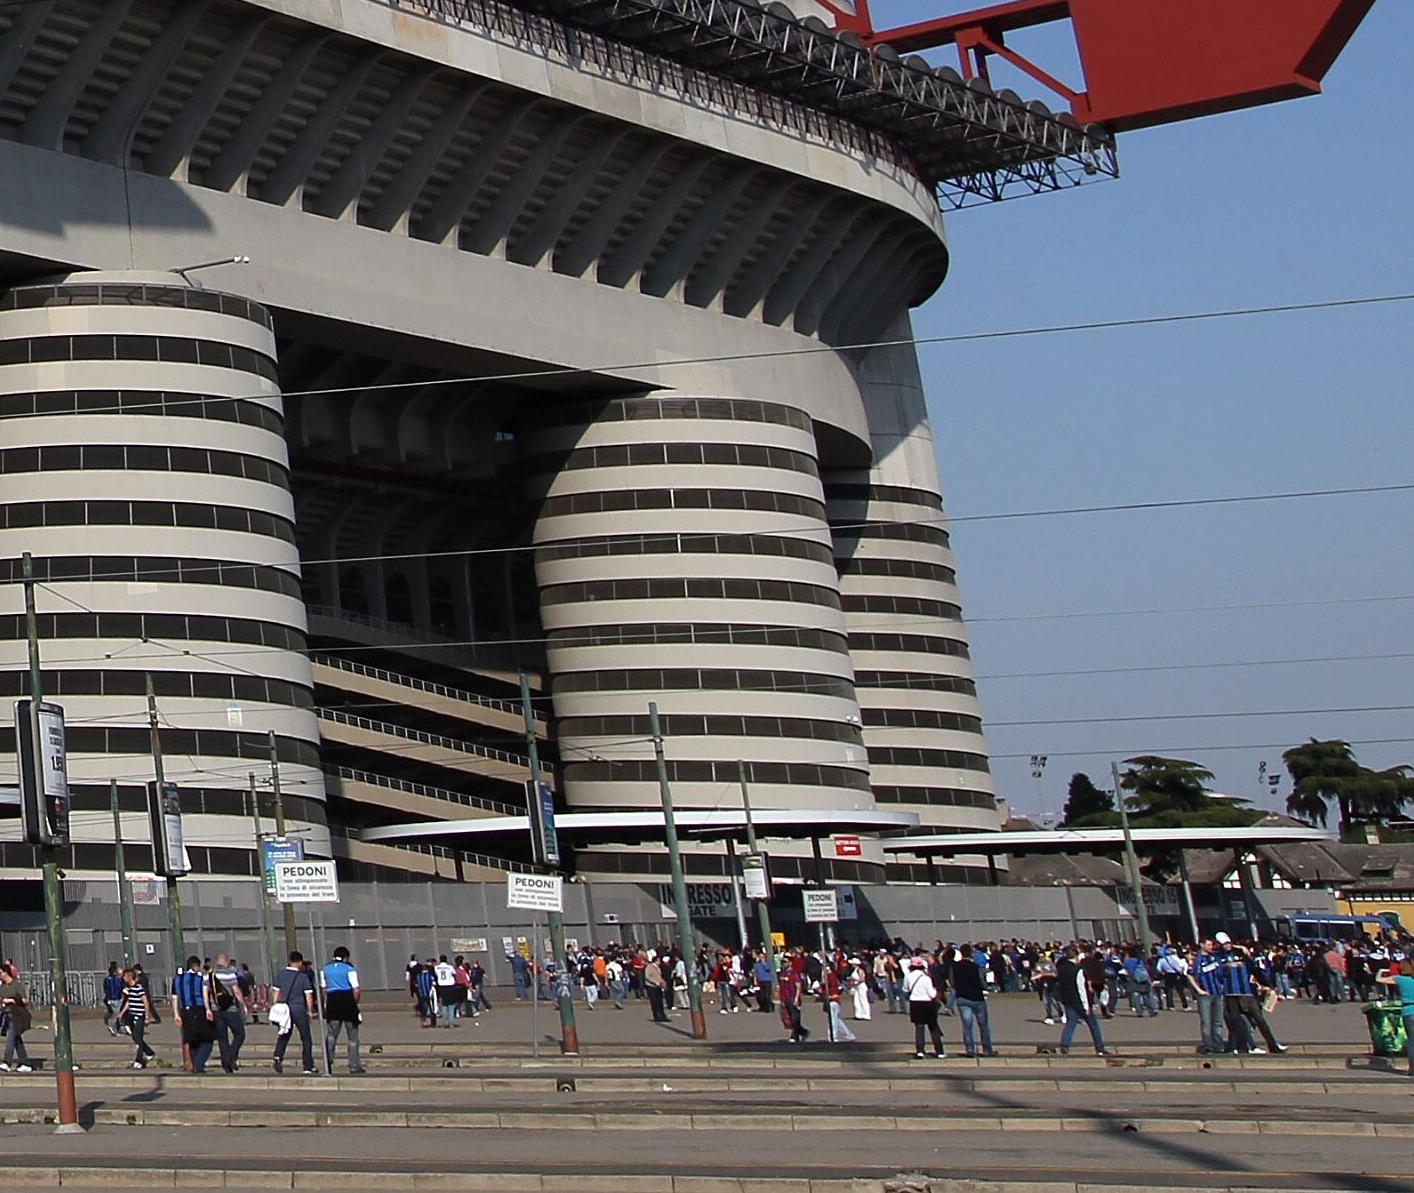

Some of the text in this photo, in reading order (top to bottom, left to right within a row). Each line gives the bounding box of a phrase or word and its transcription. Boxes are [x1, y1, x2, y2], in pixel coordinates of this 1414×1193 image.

[283, 867, 327, 877] PEDONI
[515, 877, 554, 888] PEDONI
[662, 885, 732, 905] INRESSO
[808, 893, 832, 902] PEDONI
